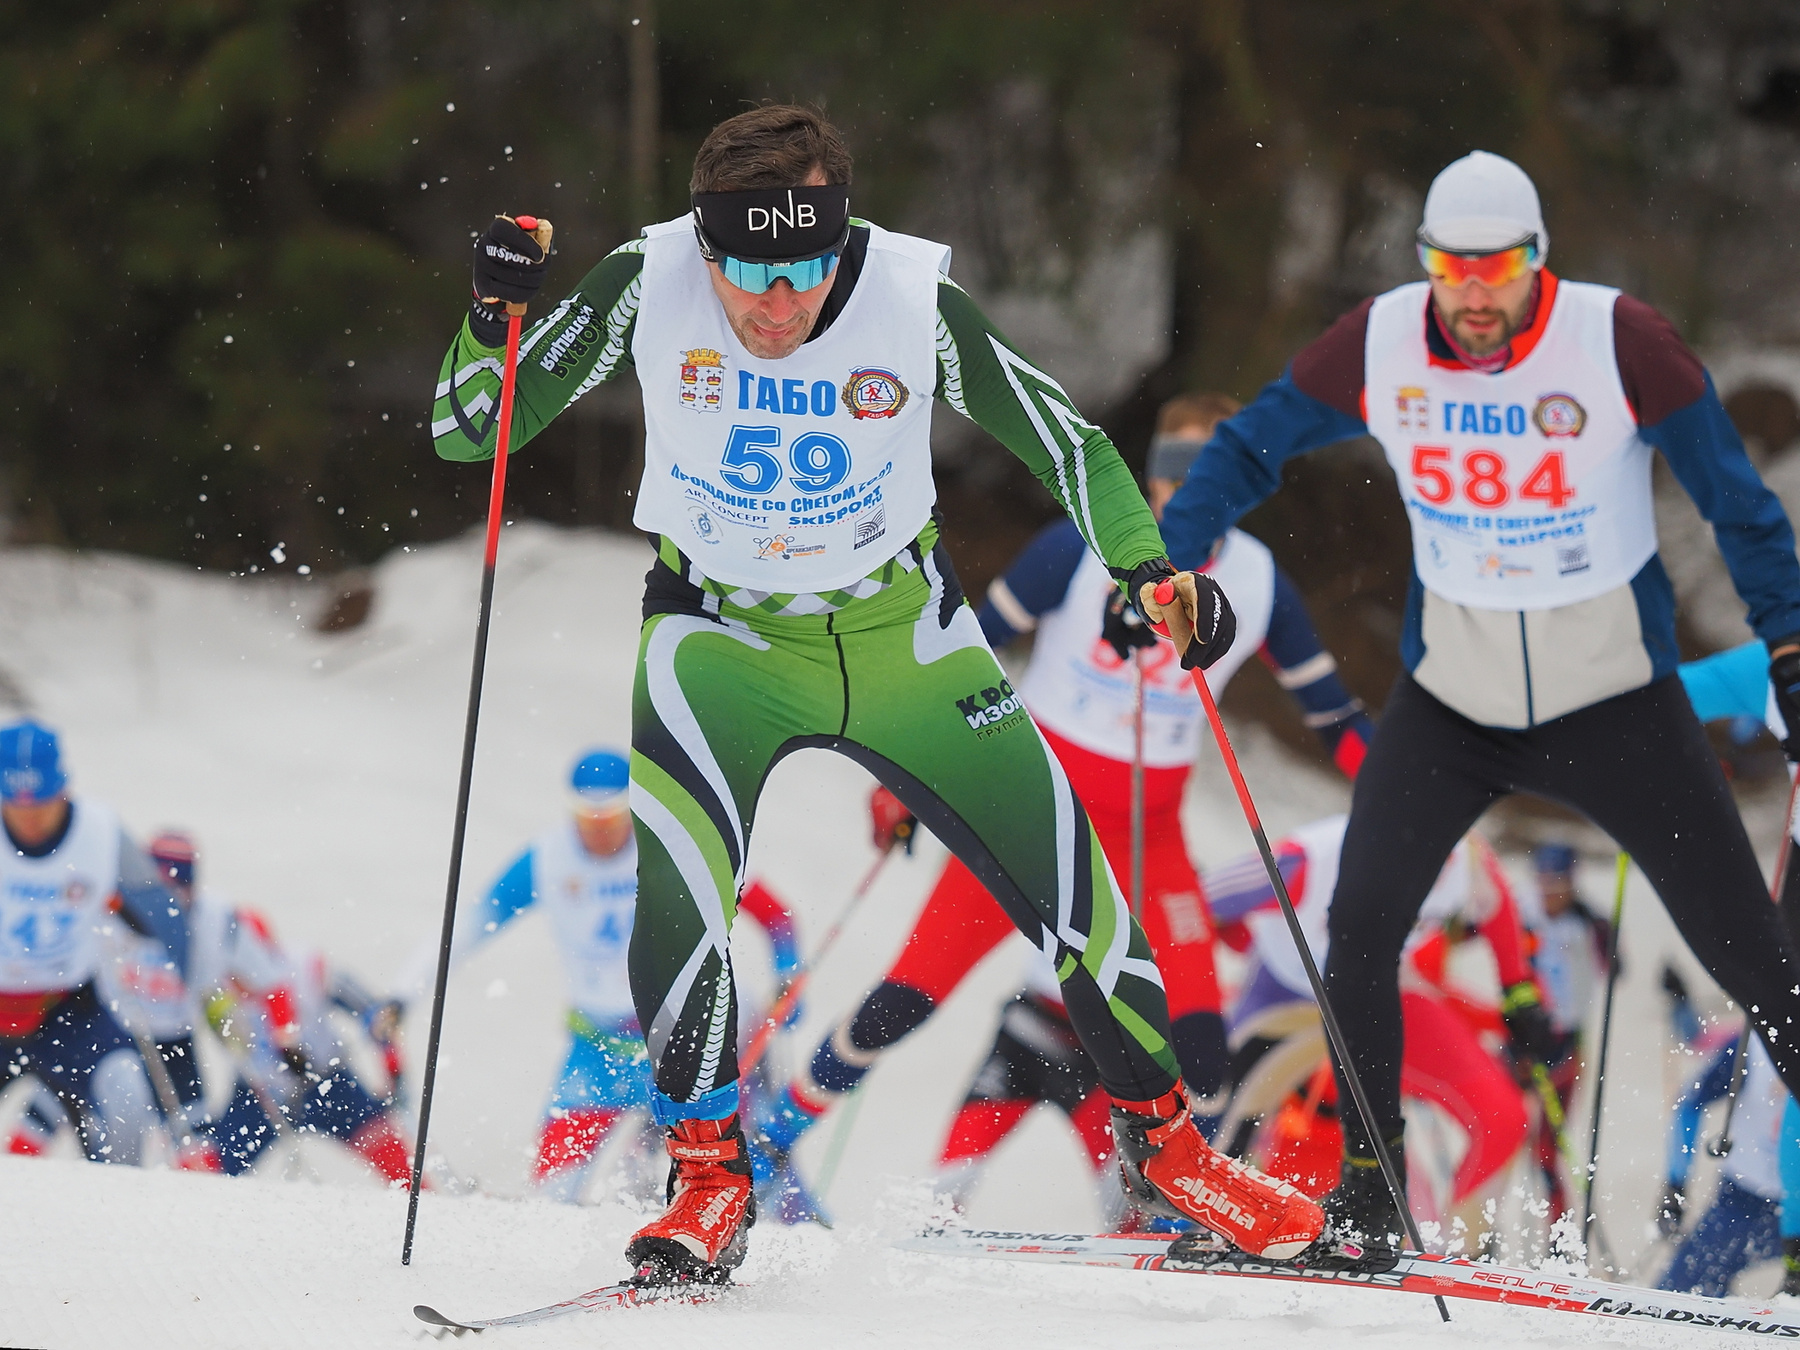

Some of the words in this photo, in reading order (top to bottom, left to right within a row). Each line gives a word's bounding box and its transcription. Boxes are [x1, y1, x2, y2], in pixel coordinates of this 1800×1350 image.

[748, 189, 817, 239] DNB
[540, 305, 594, 371] ИОЛЯЦИЯ
[738, 369, 837, 417] ГАБО
[1443, 401, 1526, 435] ГАБО
[720, 424, 852, 494] 59
[1411, 445, 1576, 510] 584
[670, 463, 758, 510] ПРОЩАНИЕ
[762, 500, 786, 511] СО
[791, 485, 856, 513] СНЕГОМ
[788, 485, 881, 525] SKISPORT
[711, 501, 769, 523] CONCEPT
[976, 714, 1025, 741] ГРУППА
[675, 1147, 720, 1157] alpina
[697, 1186, 740, 1231] alpina
[1173, 1176, 1256, 1230] alpina
[1161, 1259, 1404, 1288] MADSHUS
[1587, 1297, 1800, 1340] MADSHUS
